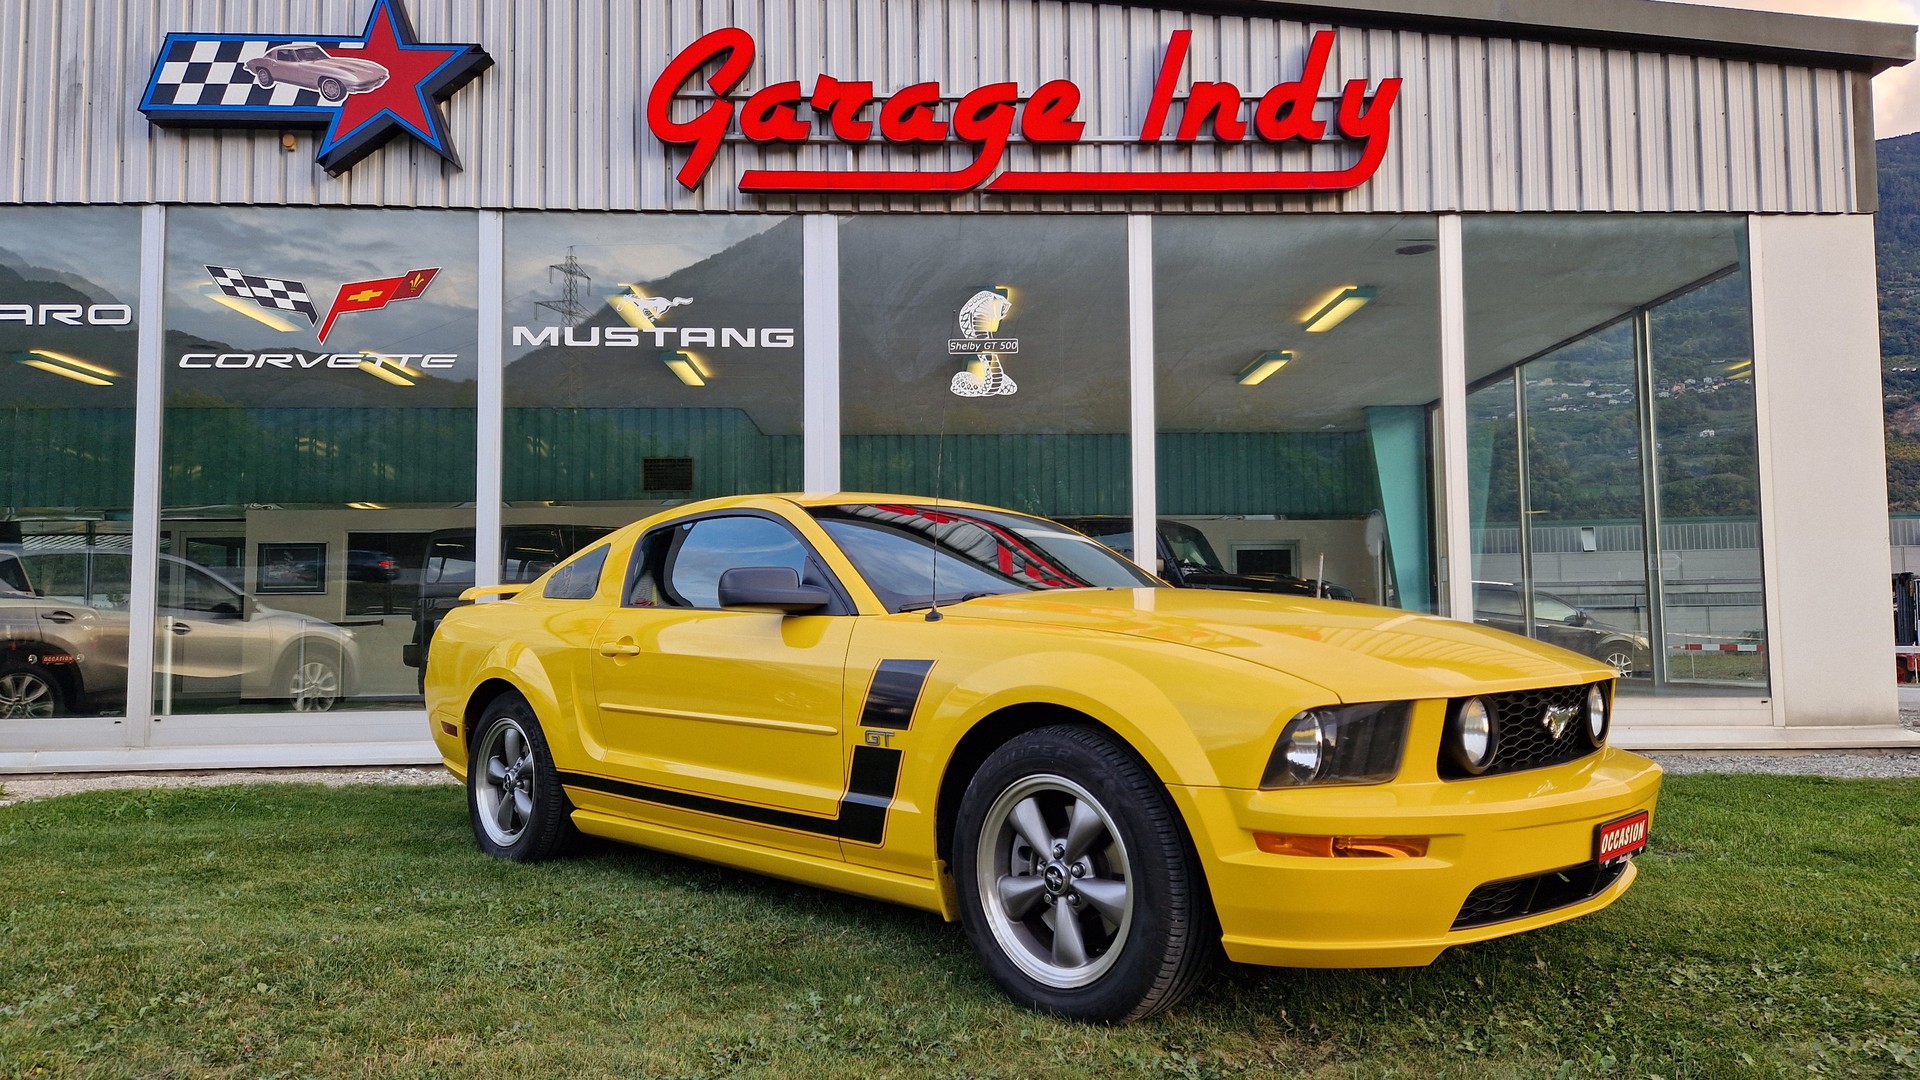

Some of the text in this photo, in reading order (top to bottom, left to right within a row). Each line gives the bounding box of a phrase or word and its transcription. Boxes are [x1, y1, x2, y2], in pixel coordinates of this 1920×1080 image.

[647, 26, 1403, 193] Garage Indy
[0, 303, 132, 326] ARO
[512, 326, 794, 348] MUSTANG
[950, 341, 1018, 352] Shelby GT 500
[178, 353, 458, 369] CORVETTE
[864, 729, 896, 748] GT
[1601, 820, 1646, 854] OCCASION
